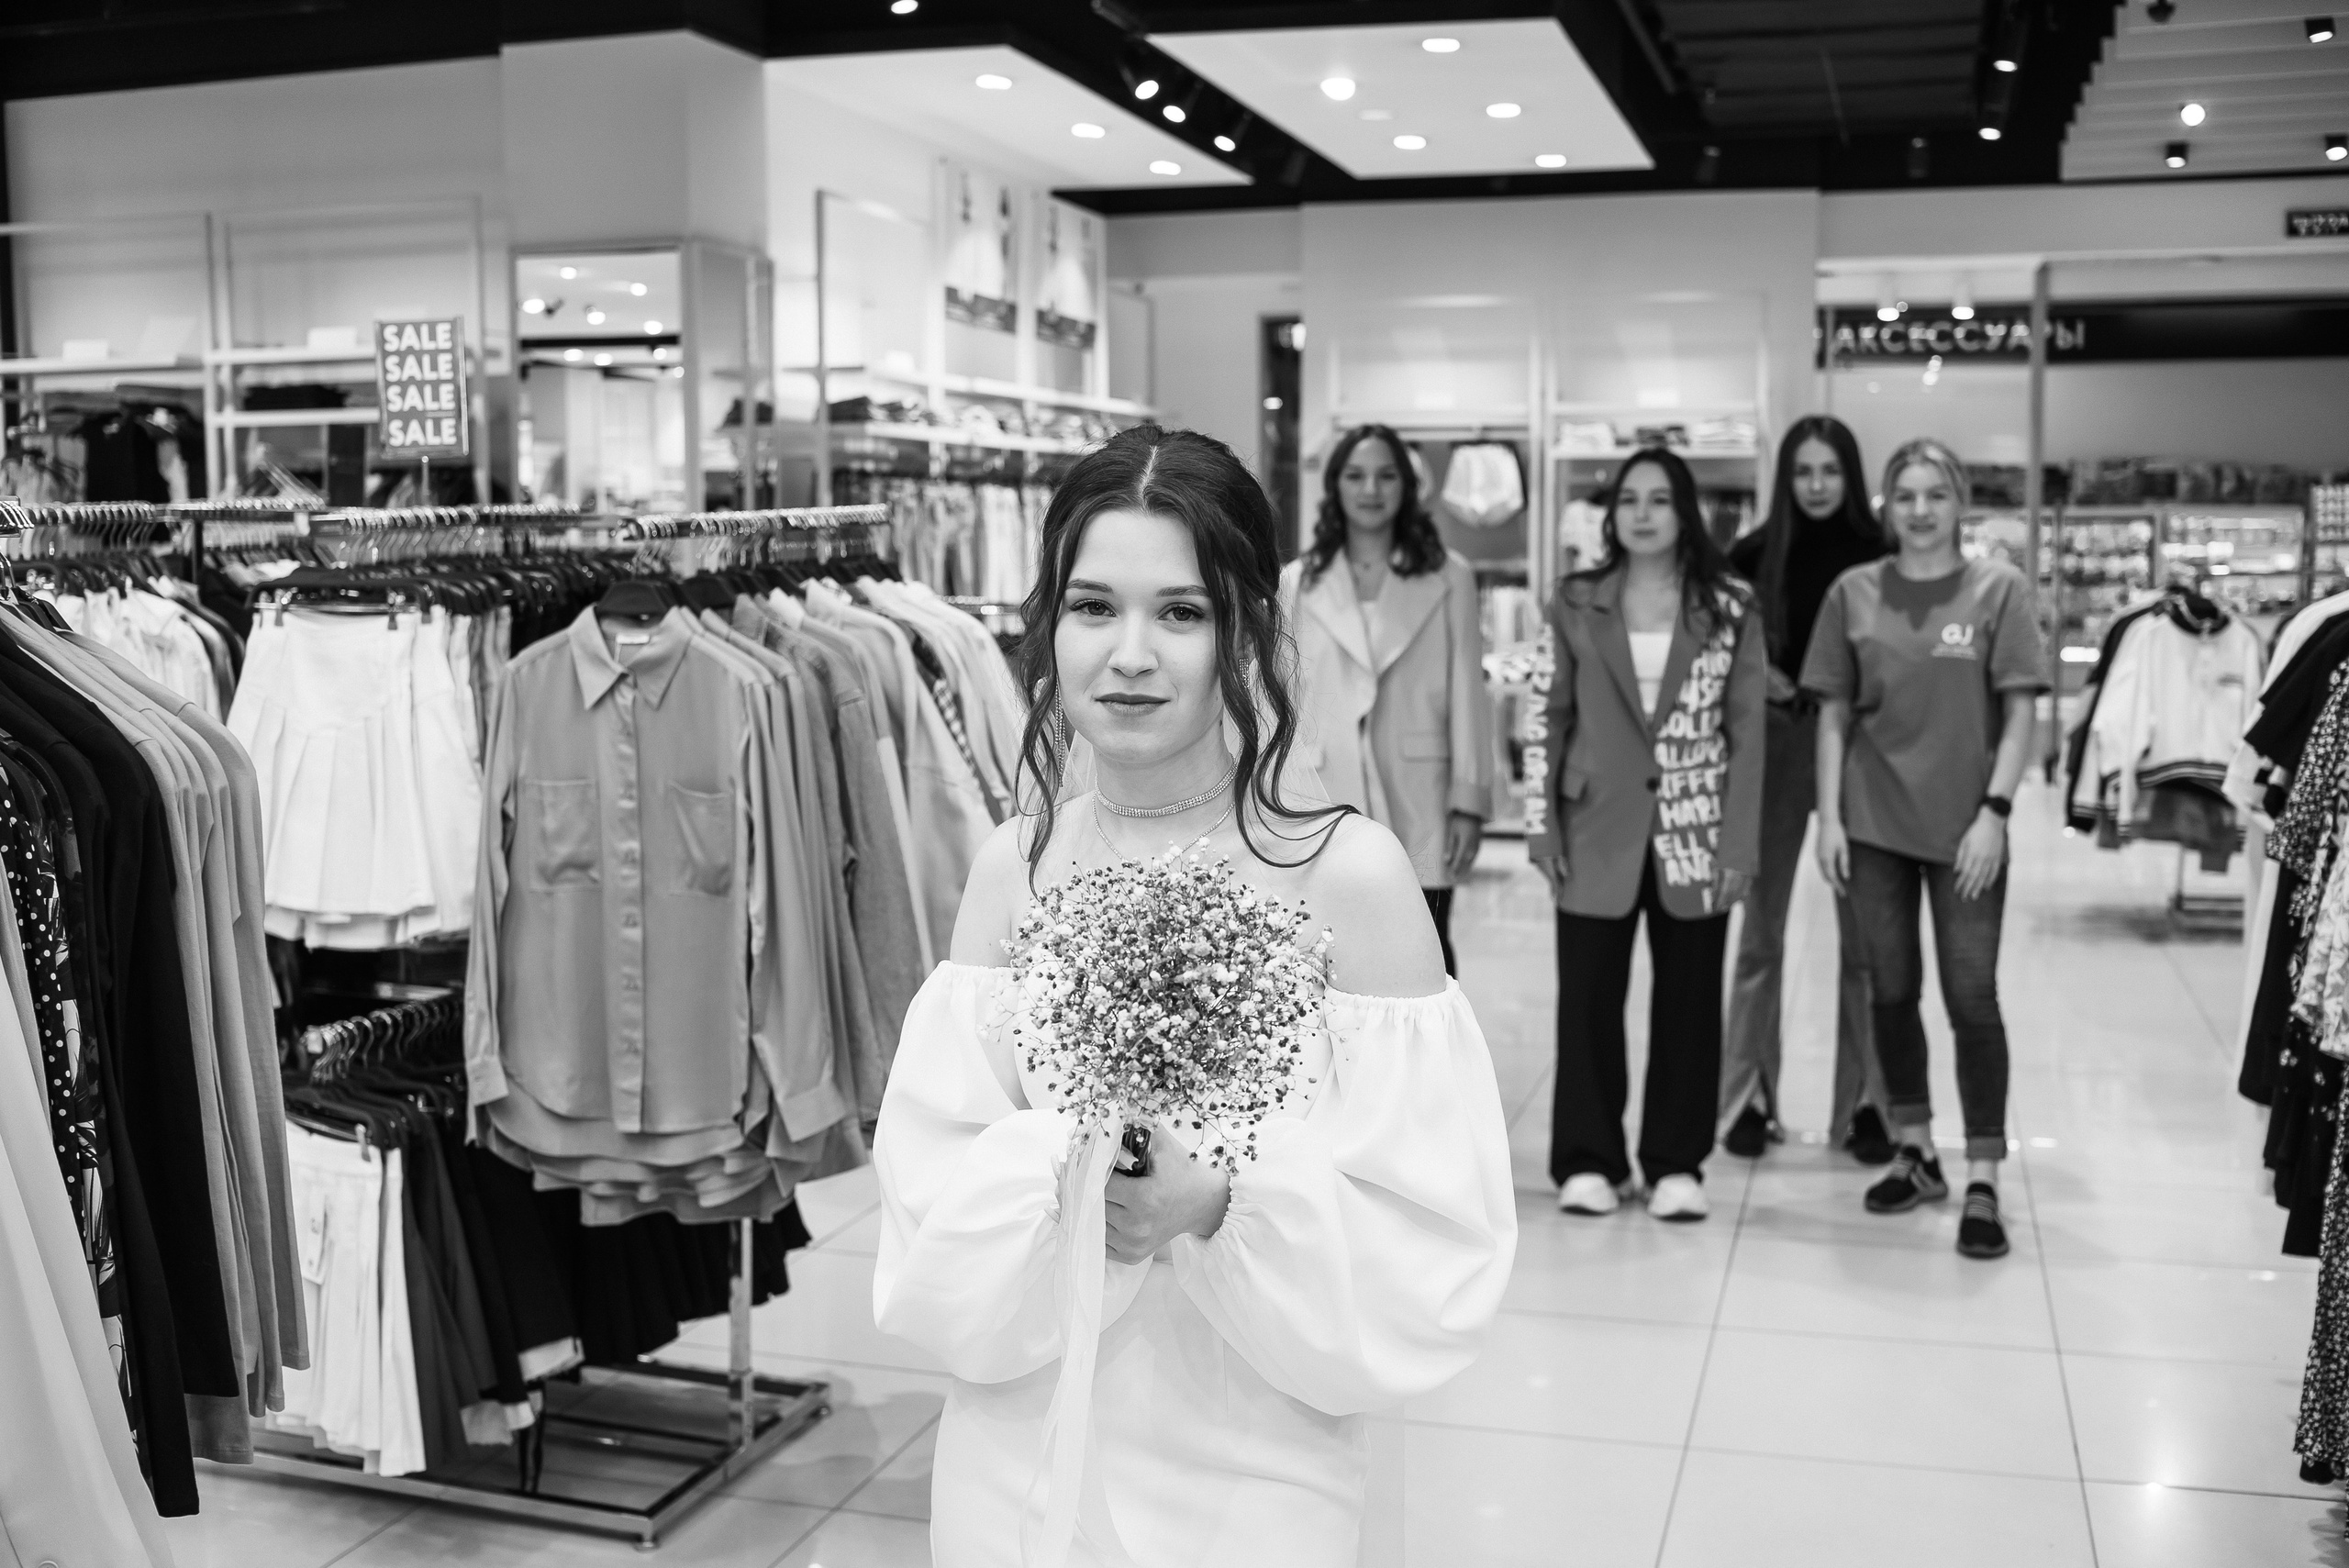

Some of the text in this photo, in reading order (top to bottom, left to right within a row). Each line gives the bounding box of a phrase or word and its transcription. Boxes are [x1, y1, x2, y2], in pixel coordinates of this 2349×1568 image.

[383, 322, 452, 352] SALE
[1835, 321, 2084, 352] АКСЕССУАЫ
[384, 352, 454, 382] SALE
[386, 383, 456, 412] SALE
[388, 417, 457, 447] SALE
